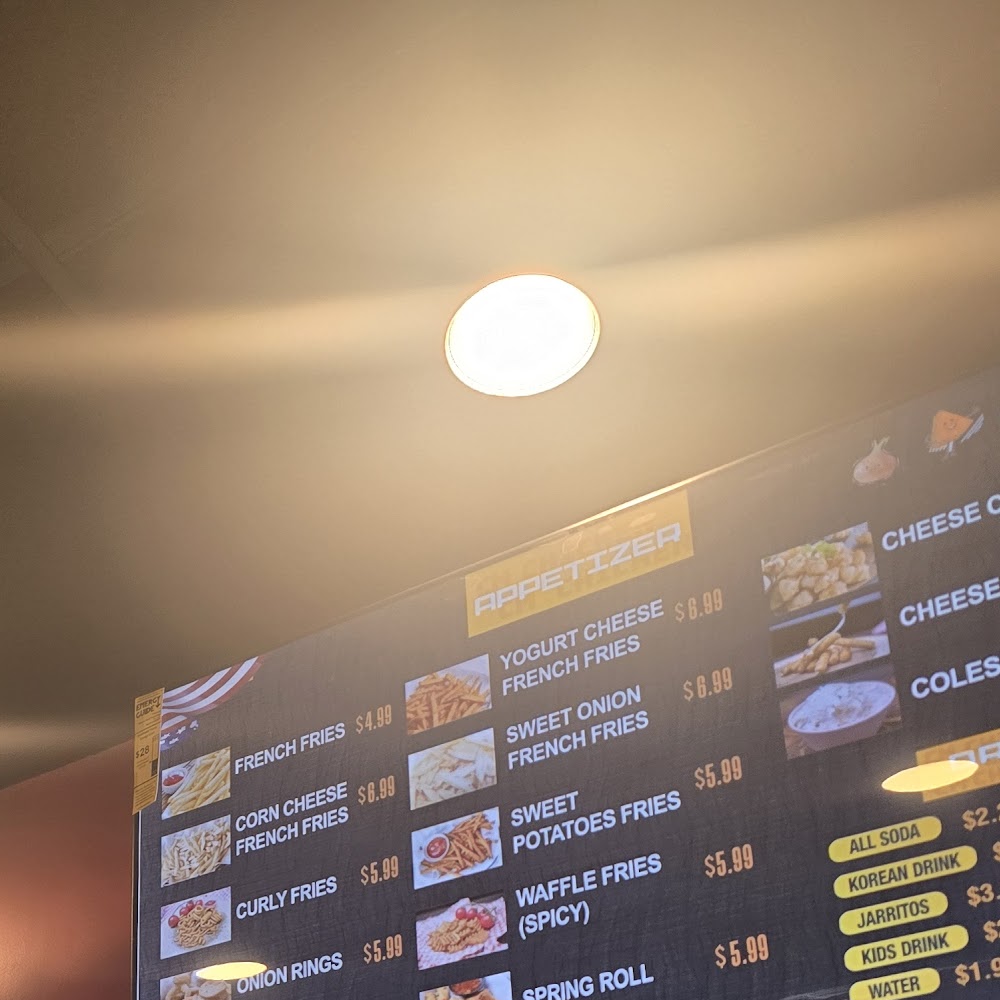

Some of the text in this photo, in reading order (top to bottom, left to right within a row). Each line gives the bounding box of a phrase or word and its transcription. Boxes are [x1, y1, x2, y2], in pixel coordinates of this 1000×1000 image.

[881, 501, 982, 552] CHEESE
[474, 522, 681, 617] APPETIZER
[674, 588, 723, 623] $6.99
[899, 576, 1000, 627] CHEESE
[500, 599, 664, 670] YOGURT CHEESE
[502, 634, 641, 696] FRENCH FRIES
[683, 667, 733, 702] $6.99
[355, 704, 392, 735] $4.99
[506, 685, 642, 743] SWEET ONION
[136, 745, 150, 758] $28
[235, 722, 346, 775] FRENCH FRIES
[507, 710, 649, 771] FRENCH FRIES
[357, 775, 395, 806] $6.99
[694, 755, 742, 790] $5.99
[235, 781, 348, 832] CORN CHEESE
[511, 791, 579, 827] SWEET
[513, 790, 682, 854] POTATOES FRIES
[236, 806, 349, 856] FRENCH FRIES
[850, 823, 921, 855] ALL SODA
[361, 855, 399, 886] $5.99
[515, 853, 663, 908] WAFFLE FRIES
[704, 844, 754, 879] $5.99
[848, 852, 961, 892] KOREAN DRINK
[236, 876, 338, 919] CURLY FRIES
[857, 899, 929, 928] JARRITOS
[518, 900, 591, 940] (SPICY)
[363, 934, 403, 964] $5.99
[861, 932, 949, 965] KIDS DRINK
[236, 952, 344, 994] ONION RINGS
[599, 963, 654, 993] ROLL
[868, 976, 920, 999] WATER
